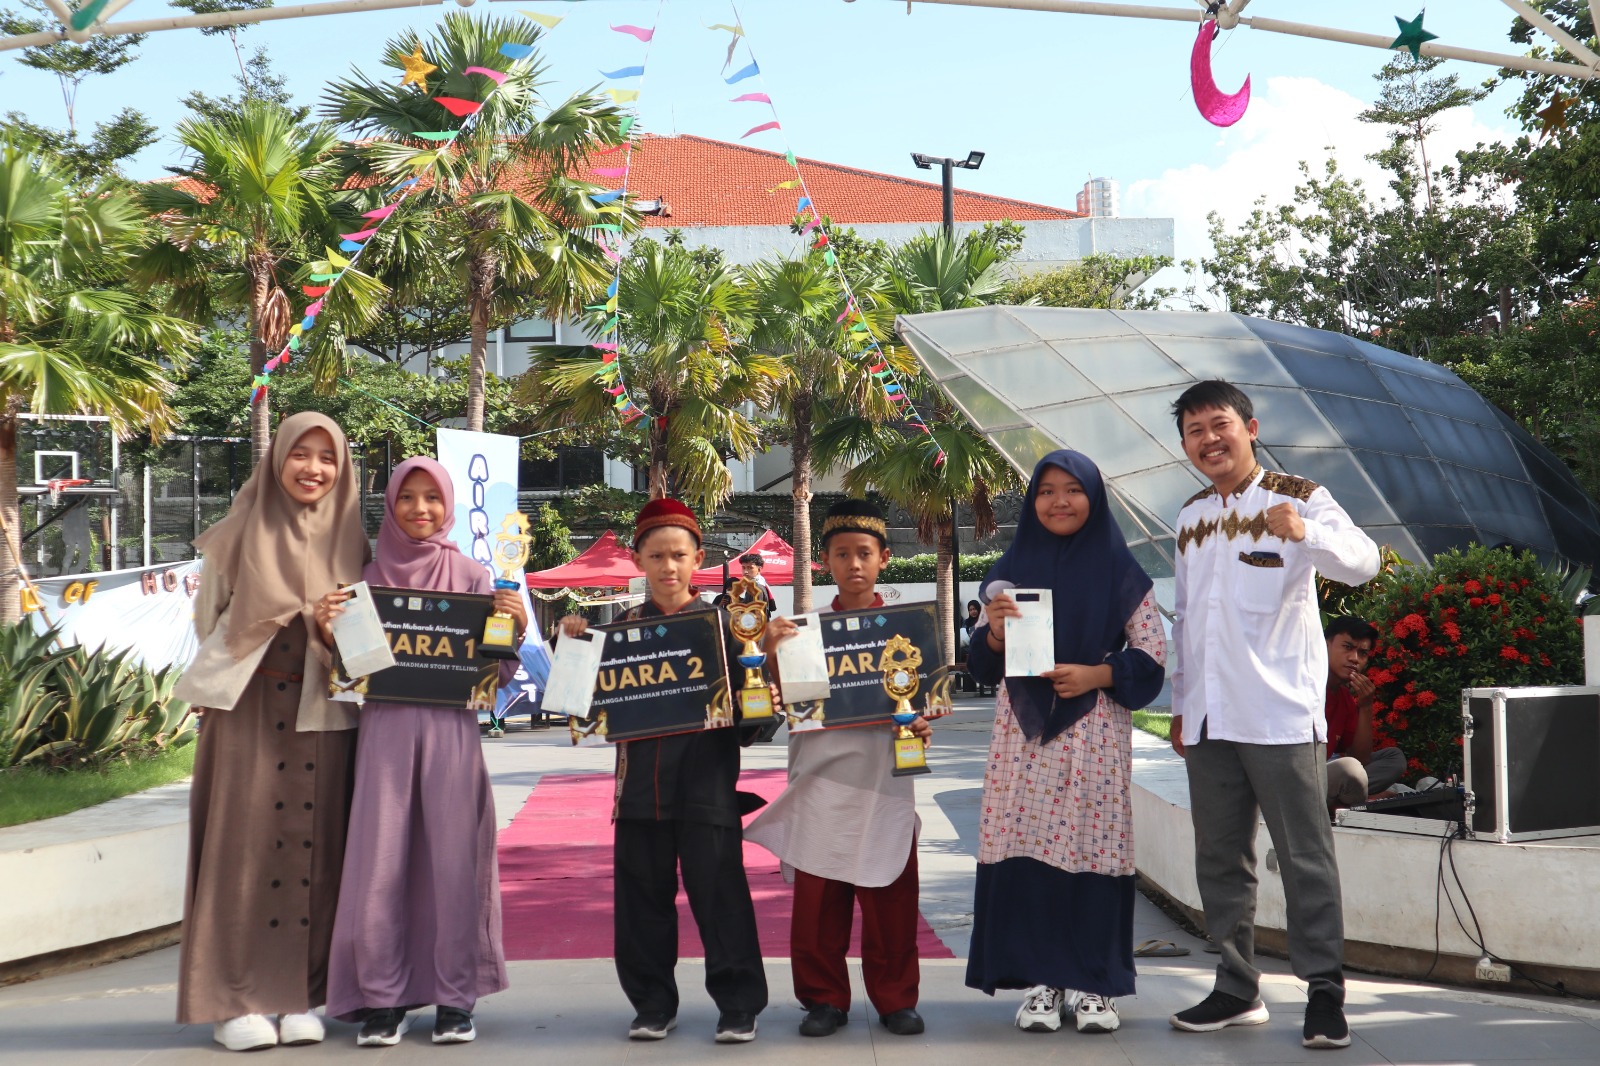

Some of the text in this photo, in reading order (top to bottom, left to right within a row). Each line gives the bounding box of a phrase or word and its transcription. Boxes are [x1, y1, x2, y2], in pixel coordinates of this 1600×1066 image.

[141, 568, 200, 598] HOP
[380, 621, 469, 635] adhan Mubarak Airlangga
[386, 632, 475, 659] ARA 1
[824, 645, 845, 653] adhan
[845, 641, 876, 651] Mubarak
[395, 661, 429, 669] AMADHAN
[429, 663, 450, 671] STORY
[600, 648, 691, 666] madhan Mubarak Airlangga
[596, 656, 705, 691] UARA 2
[842, 678, 879, 689] RAMADHAN
[591, 684, 708, 706] IRLANGGA RAMADHAN STORY TELLING
